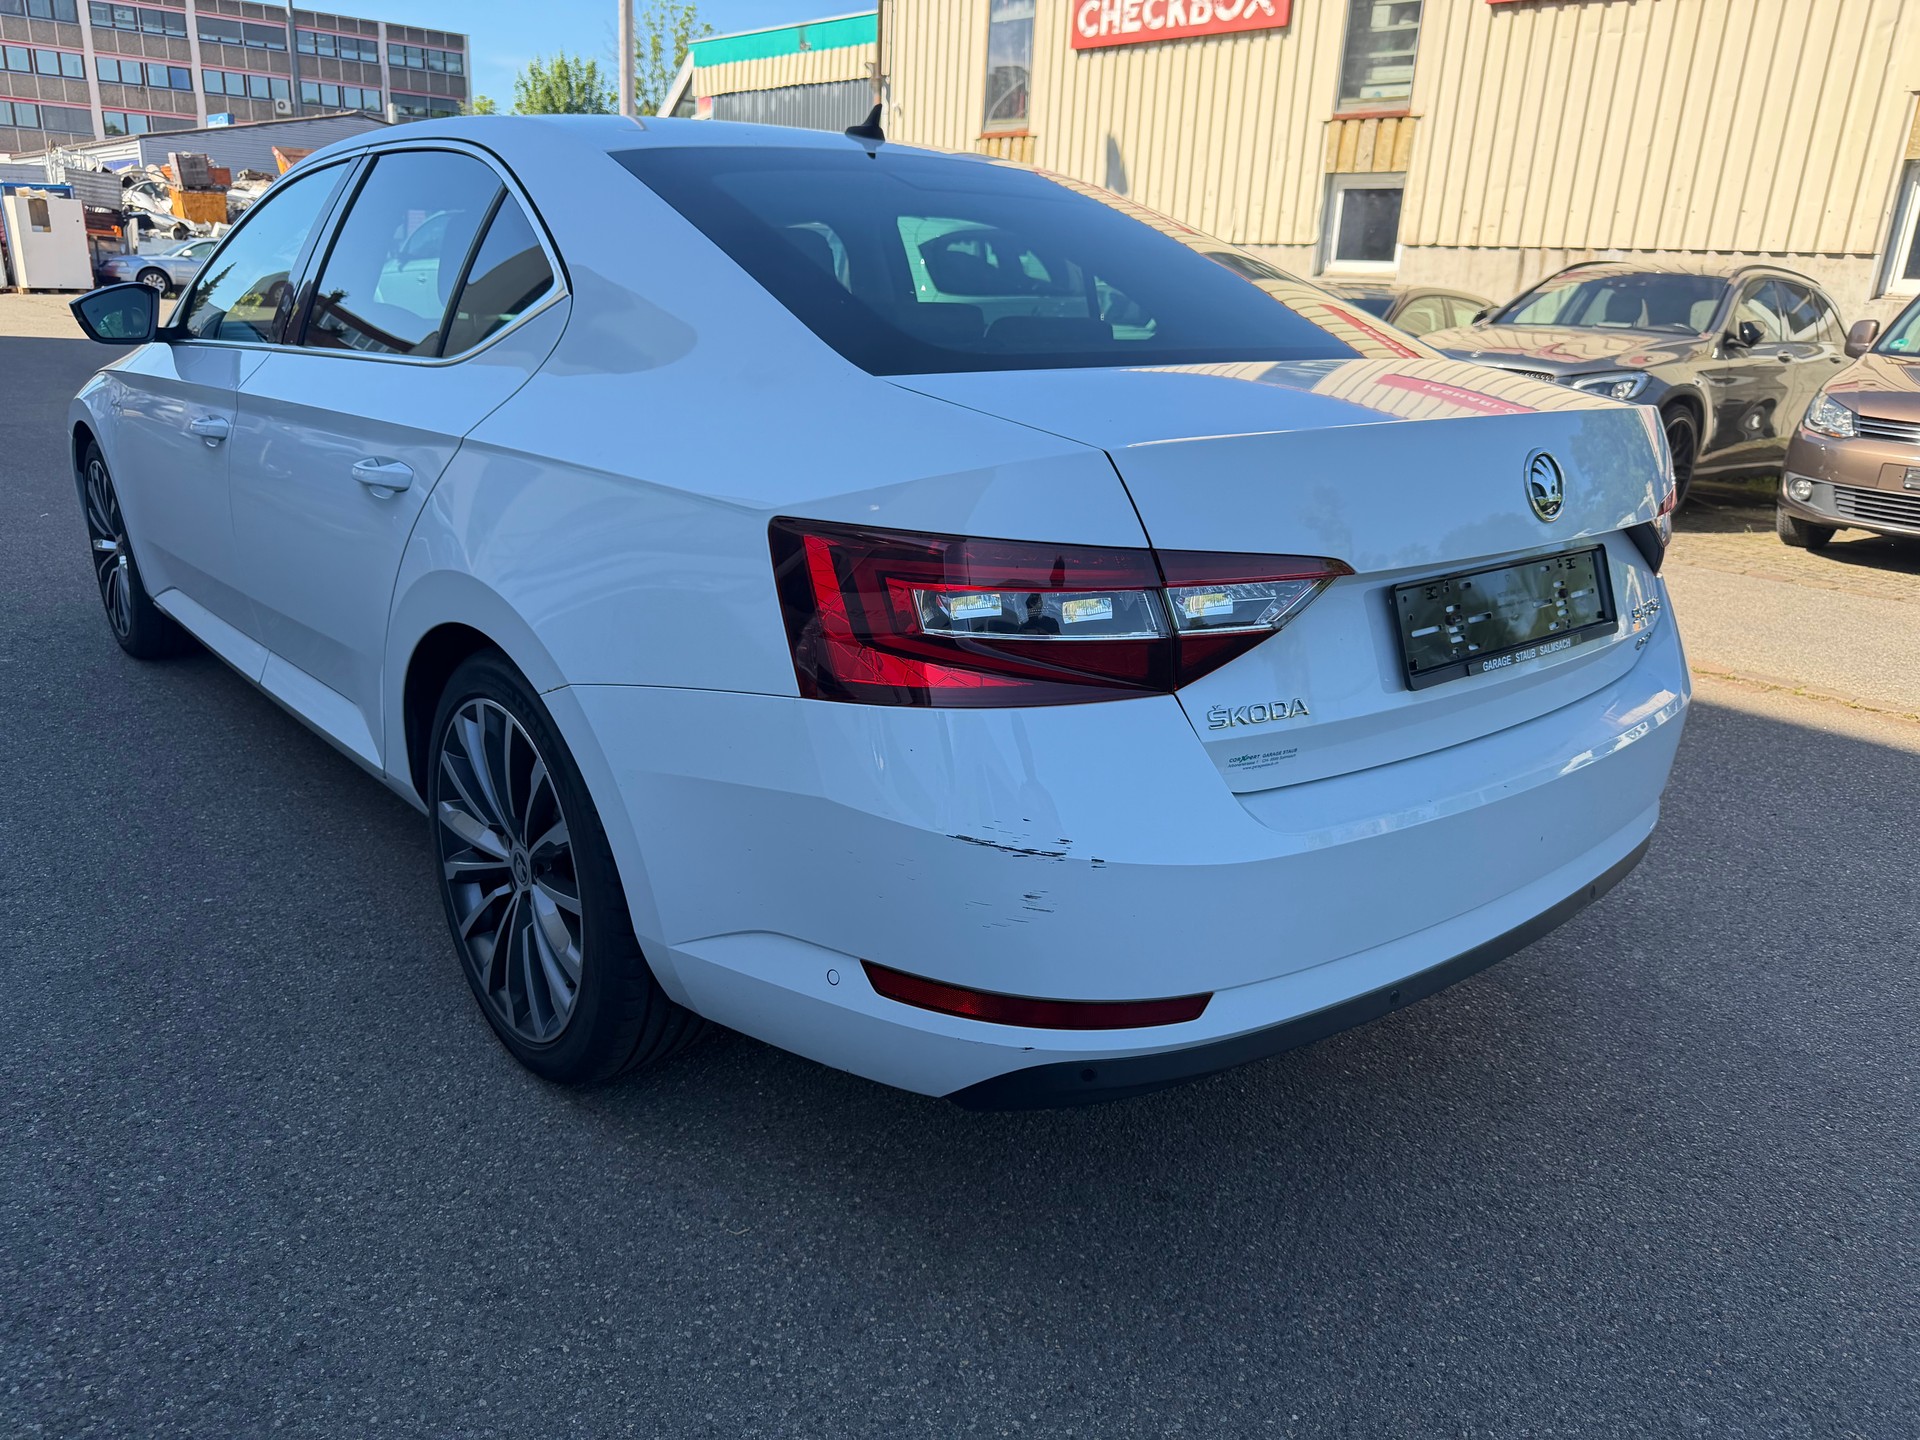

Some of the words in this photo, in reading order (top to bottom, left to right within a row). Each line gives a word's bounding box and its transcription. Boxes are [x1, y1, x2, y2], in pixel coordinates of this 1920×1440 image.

[1482, 655, 1512, 672] GARAGE
[1515, 648, 1537, 662] STAUB
[1539, 638, 1571, 655] SALMSACH
[1207, 697, 1310, 730] ŠKODA
[1262, 750, 1282, 759] GARAGE
[1282, 747, 1298, 755] STAUB
